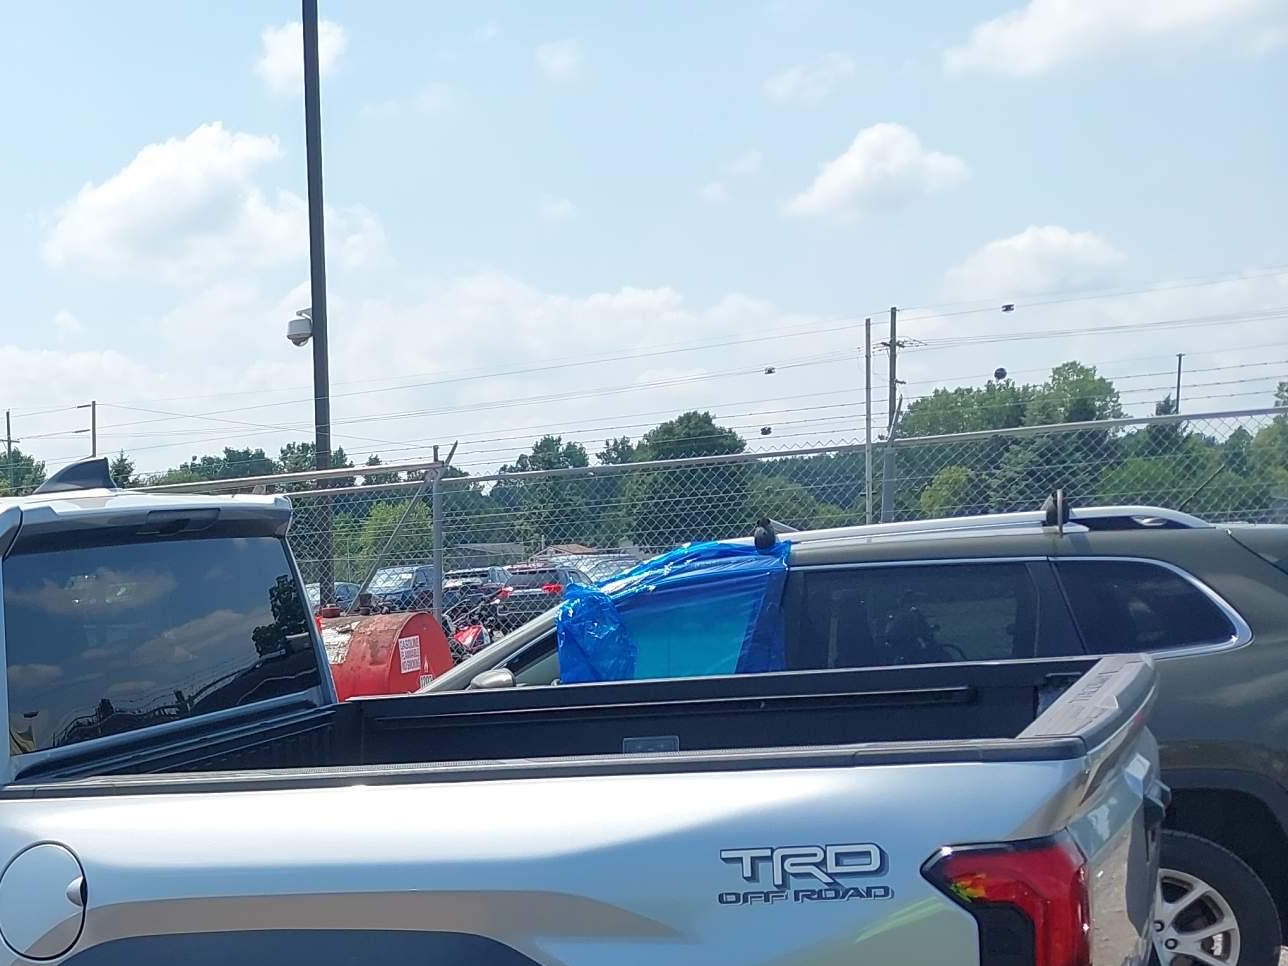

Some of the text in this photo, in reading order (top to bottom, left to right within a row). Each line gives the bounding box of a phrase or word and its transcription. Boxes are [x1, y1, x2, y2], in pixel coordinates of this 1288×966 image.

[719, 842, 890, 889] TRD
[718, 886, 895, 905] OFF ROAD
